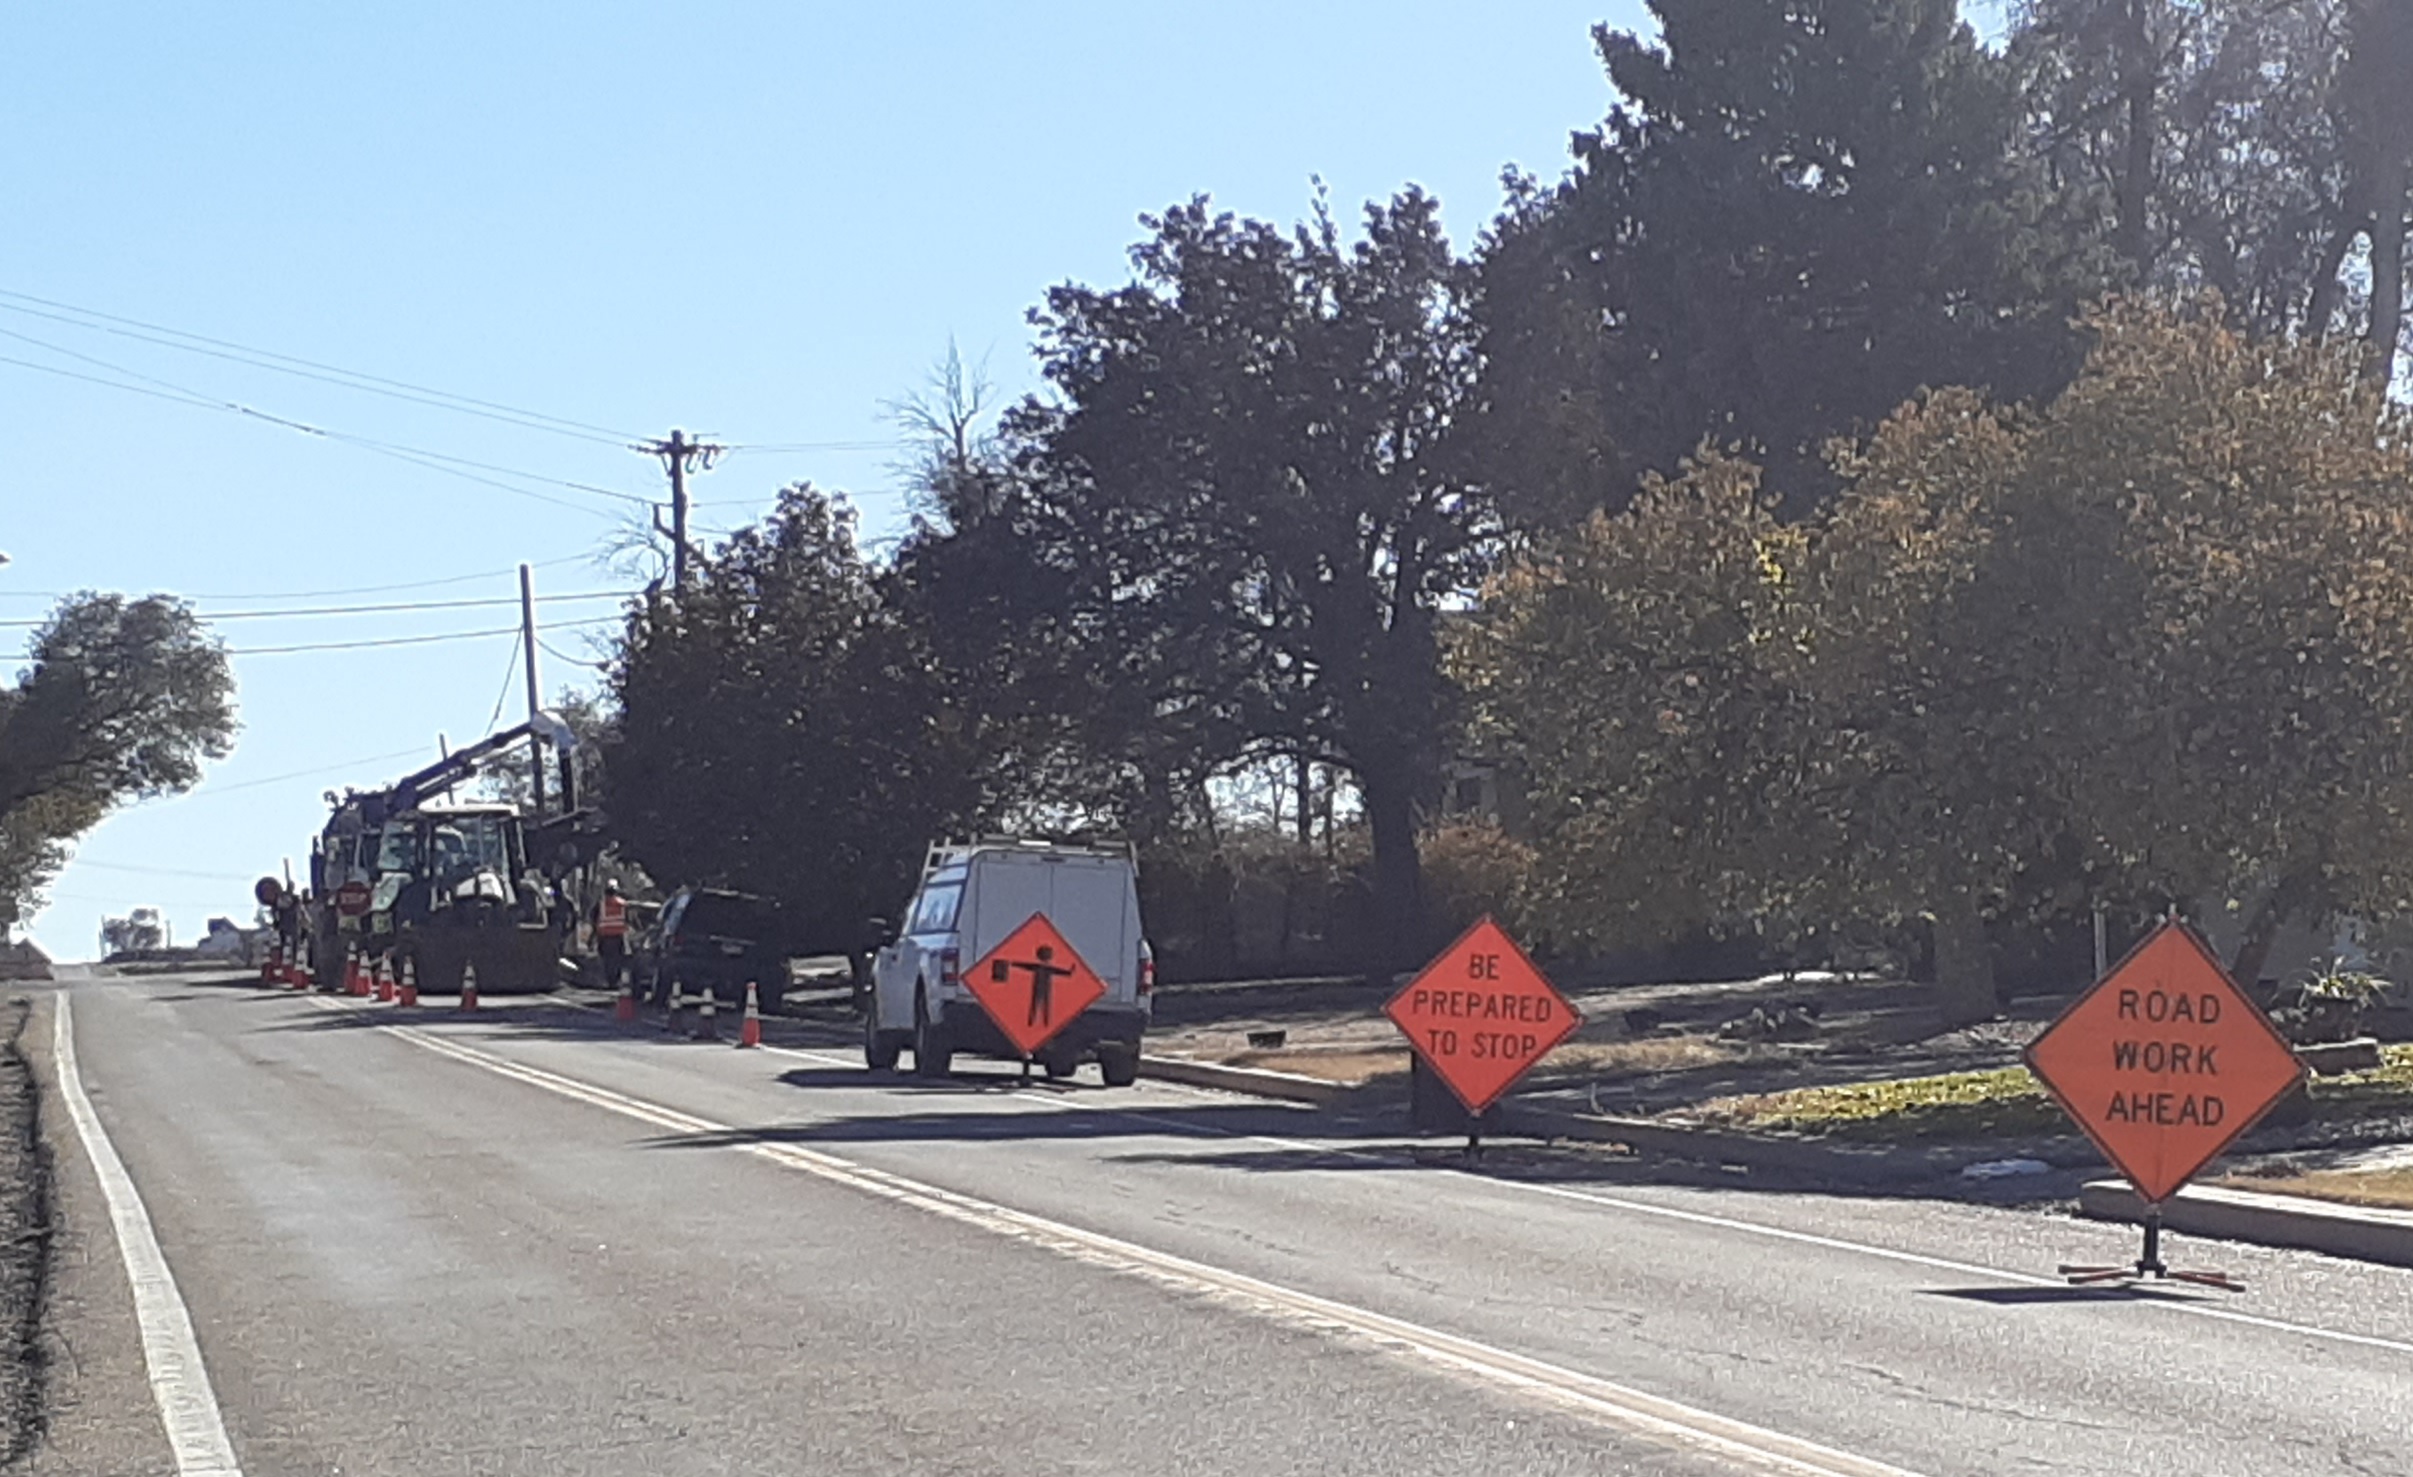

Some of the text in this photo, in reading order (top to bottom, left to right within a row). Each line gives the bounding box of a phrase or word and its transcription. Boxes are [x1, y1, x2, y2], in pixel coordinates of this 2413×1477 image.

[1468, 953, 1500, 980] BE
[1412, 990, 1551, 1022] PREPARED
[2118, 988, 2221, 1024] ROAD
[1428, 1029, 1537, 1060] TO STOP
[2113, 1040, 2218, 1075] WORK
[2105, 1091, 2225, 1126] AHEAD
